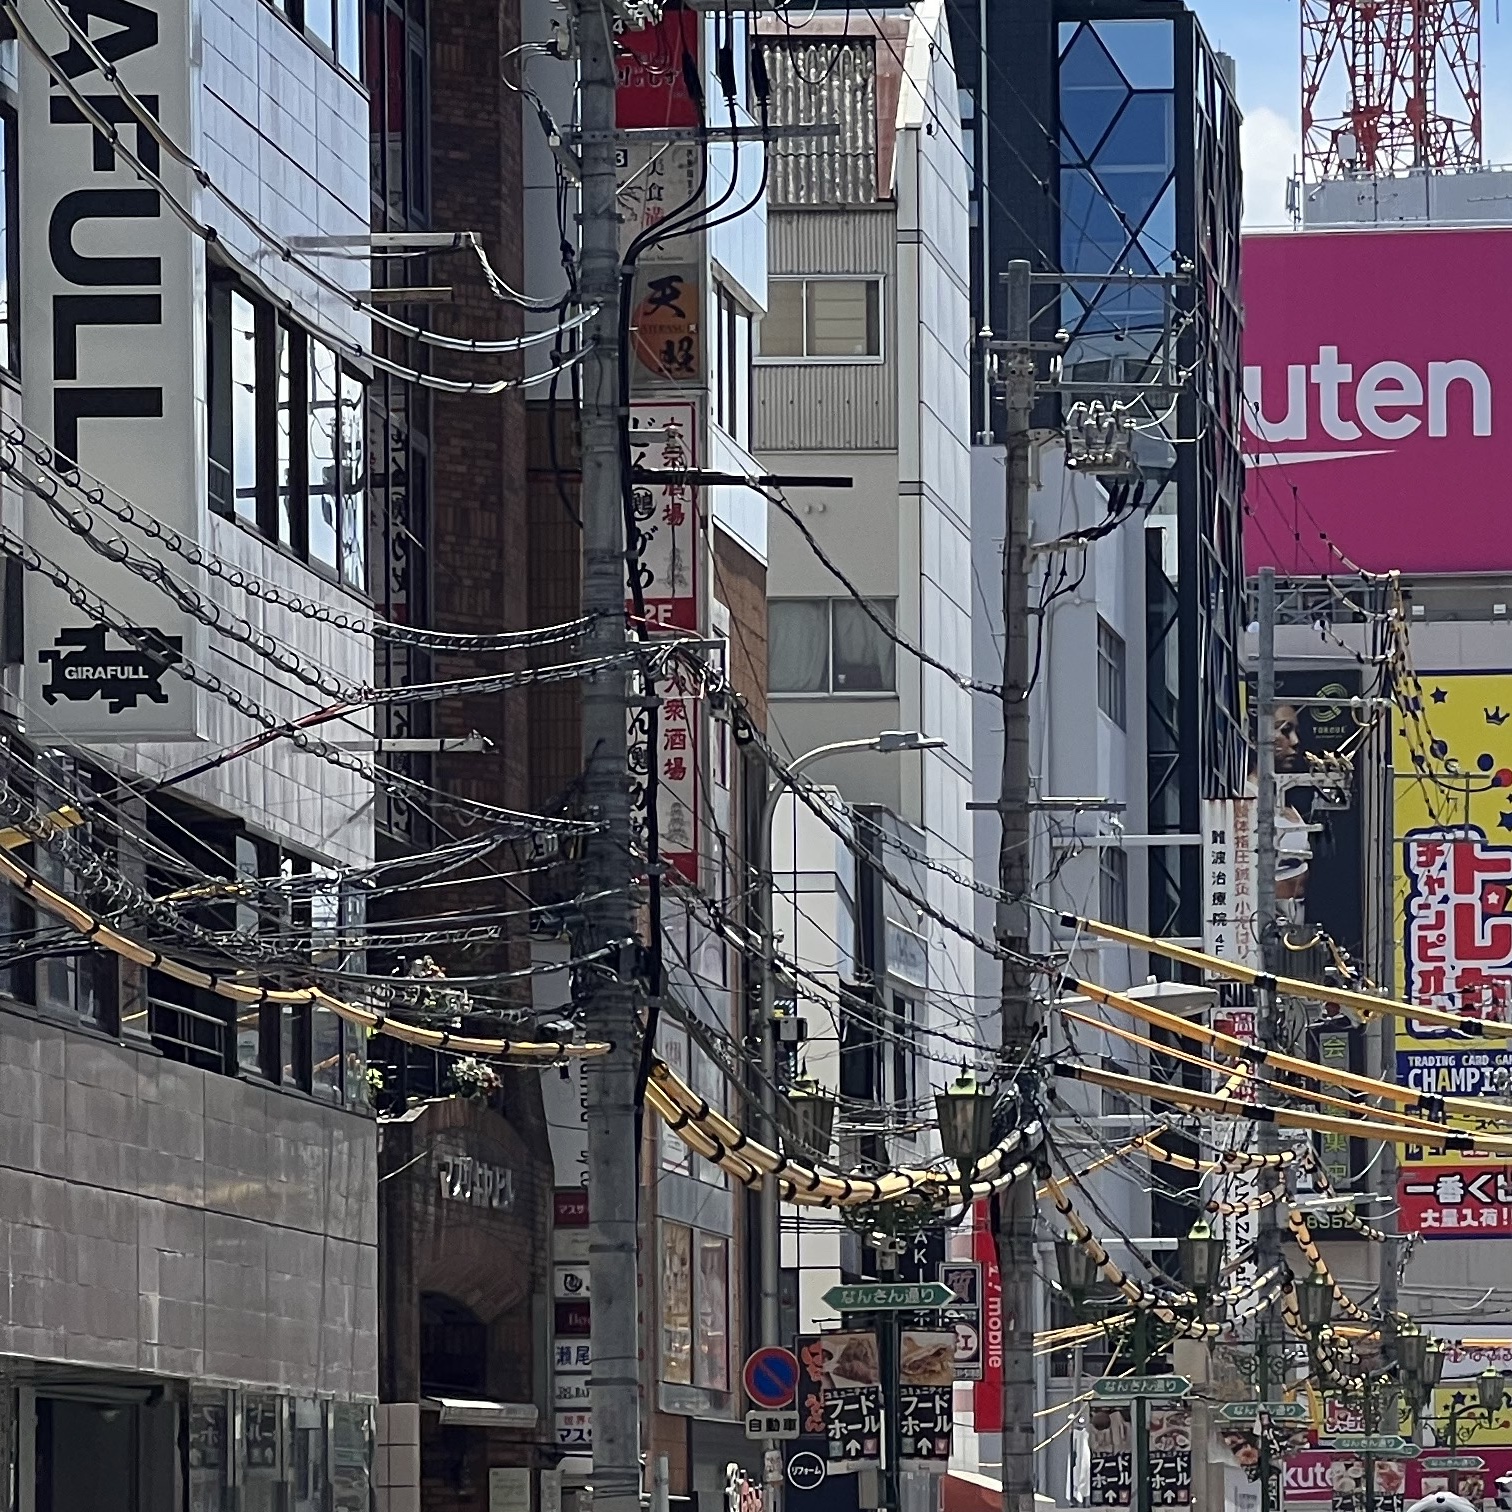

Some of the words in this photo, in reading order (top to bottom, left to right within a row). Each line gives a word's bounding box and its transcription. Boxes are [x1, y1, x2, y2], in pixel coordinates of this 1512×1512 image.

[644, 604, 673, 622] 2F
[64, 664, 150, 681] GIRAFULL
[1408, 1056, 1456, 1067] TRADING
[1462, 1054, 1490, 1066] CARD
[840, 1288, 935, 1303] なんさん通り
[1104, 1381, 1176, 1392] なんさん通り
[825, 1394, 875, 1419] フード
[900, 1394, 950, 1416] フード
[749, 1417, 798, 1433] 自動車
[828, 1416, 881, 1439] ホール
[901, 1416, 953, 1436] ホール
[791, 1466, 822, 1476] リフォーム
[1092, 1455, 1131, 1474] フード
[1151, 1455, 1190, 1474] フード
[1092, 1472, 1132, 1489] ホール
[1151, 1472, 1191, 1489] ホール
